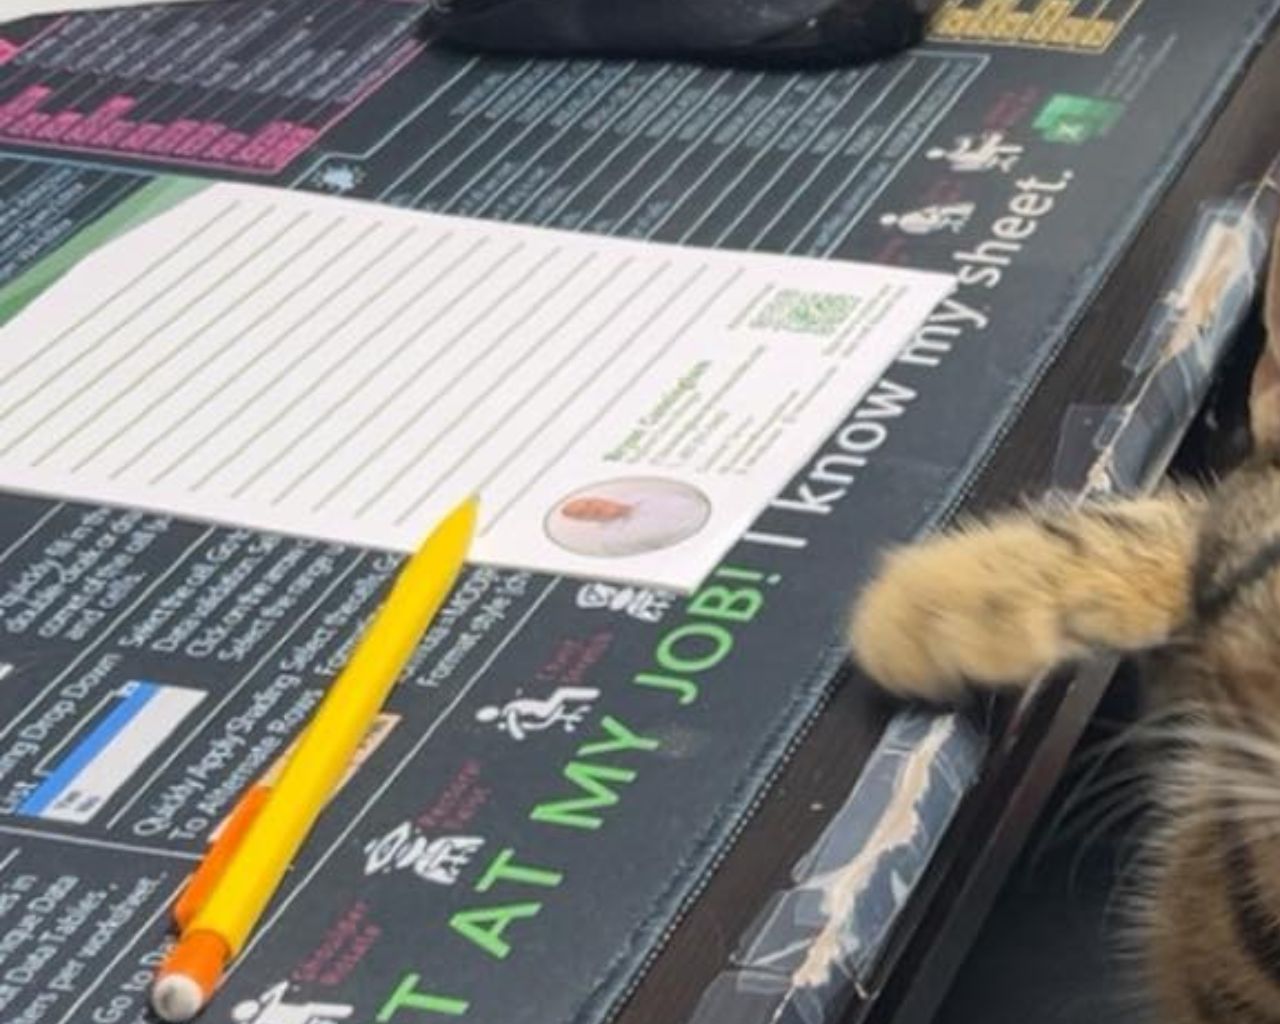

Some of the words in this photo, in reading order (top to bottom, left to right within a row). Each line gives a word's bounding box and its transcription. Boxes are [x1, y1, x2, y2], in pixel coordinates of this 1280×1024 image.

[449, 847, 564, 959] AT
[529, 714, 660, 830] MY
[632, 562, 781, 705] JOB!
[741, 530, 809, 549] I
[776, 377, 918, 516] know
[900, 289, 991, 368] my
[953, 168, 1074, 289] sheet.
[117, 608, 176, 648] Select
[152, 617, 201, 651] Data
[185, 623, 230, 657] Click
[221, 604, 251, 627] on
[217, 617, 277, 662] Select
[260, 593, 298, 619] the
[285, 556, 335, 598] range
[20, 699, 76, 742] Drop
[60, 652, 124, 700] Down
[226, 673, 301, 733] Shading
[168, 816, 208, 841] To
[197, 735, 274, 814] Alternate
[267, 688, 323, 735] Rows
[26, 875, 80, 914] Data
[4, 945, 58, 984] Data
[47, 958, 86, 992] per
[92, 994, 134, 1024] Go
[119, 970, 155, 992] to
